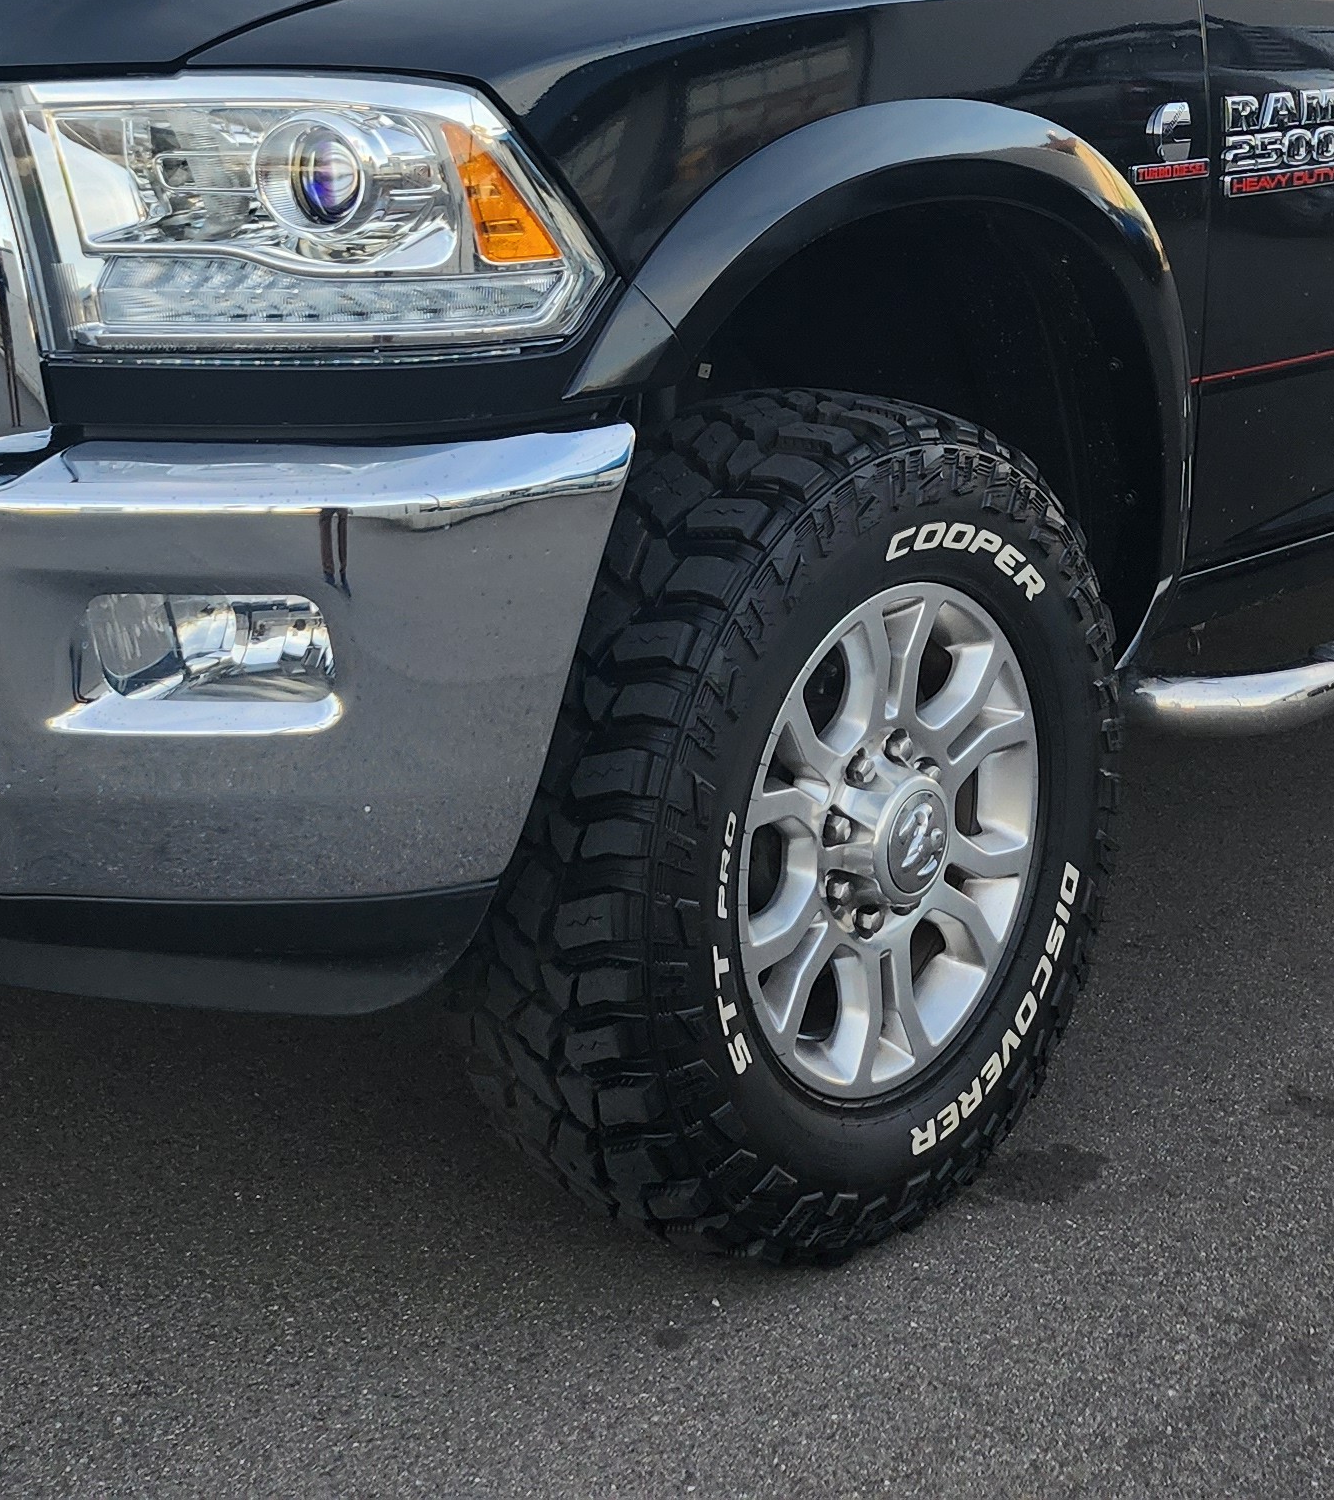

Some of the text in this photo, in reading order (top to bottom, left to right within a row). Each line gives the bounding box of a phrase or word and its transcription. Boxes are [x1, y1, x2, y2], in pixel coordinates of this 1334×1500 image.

[1138, 166, 1172, 181] TURBO
[1232, 174, 1291, 193] HEAVY
[885, 520, 1047, 602] COOPER
[712, 810, 753, 1076] STT PRO
[909, 860, 1080, 1157] DISCOVERER
